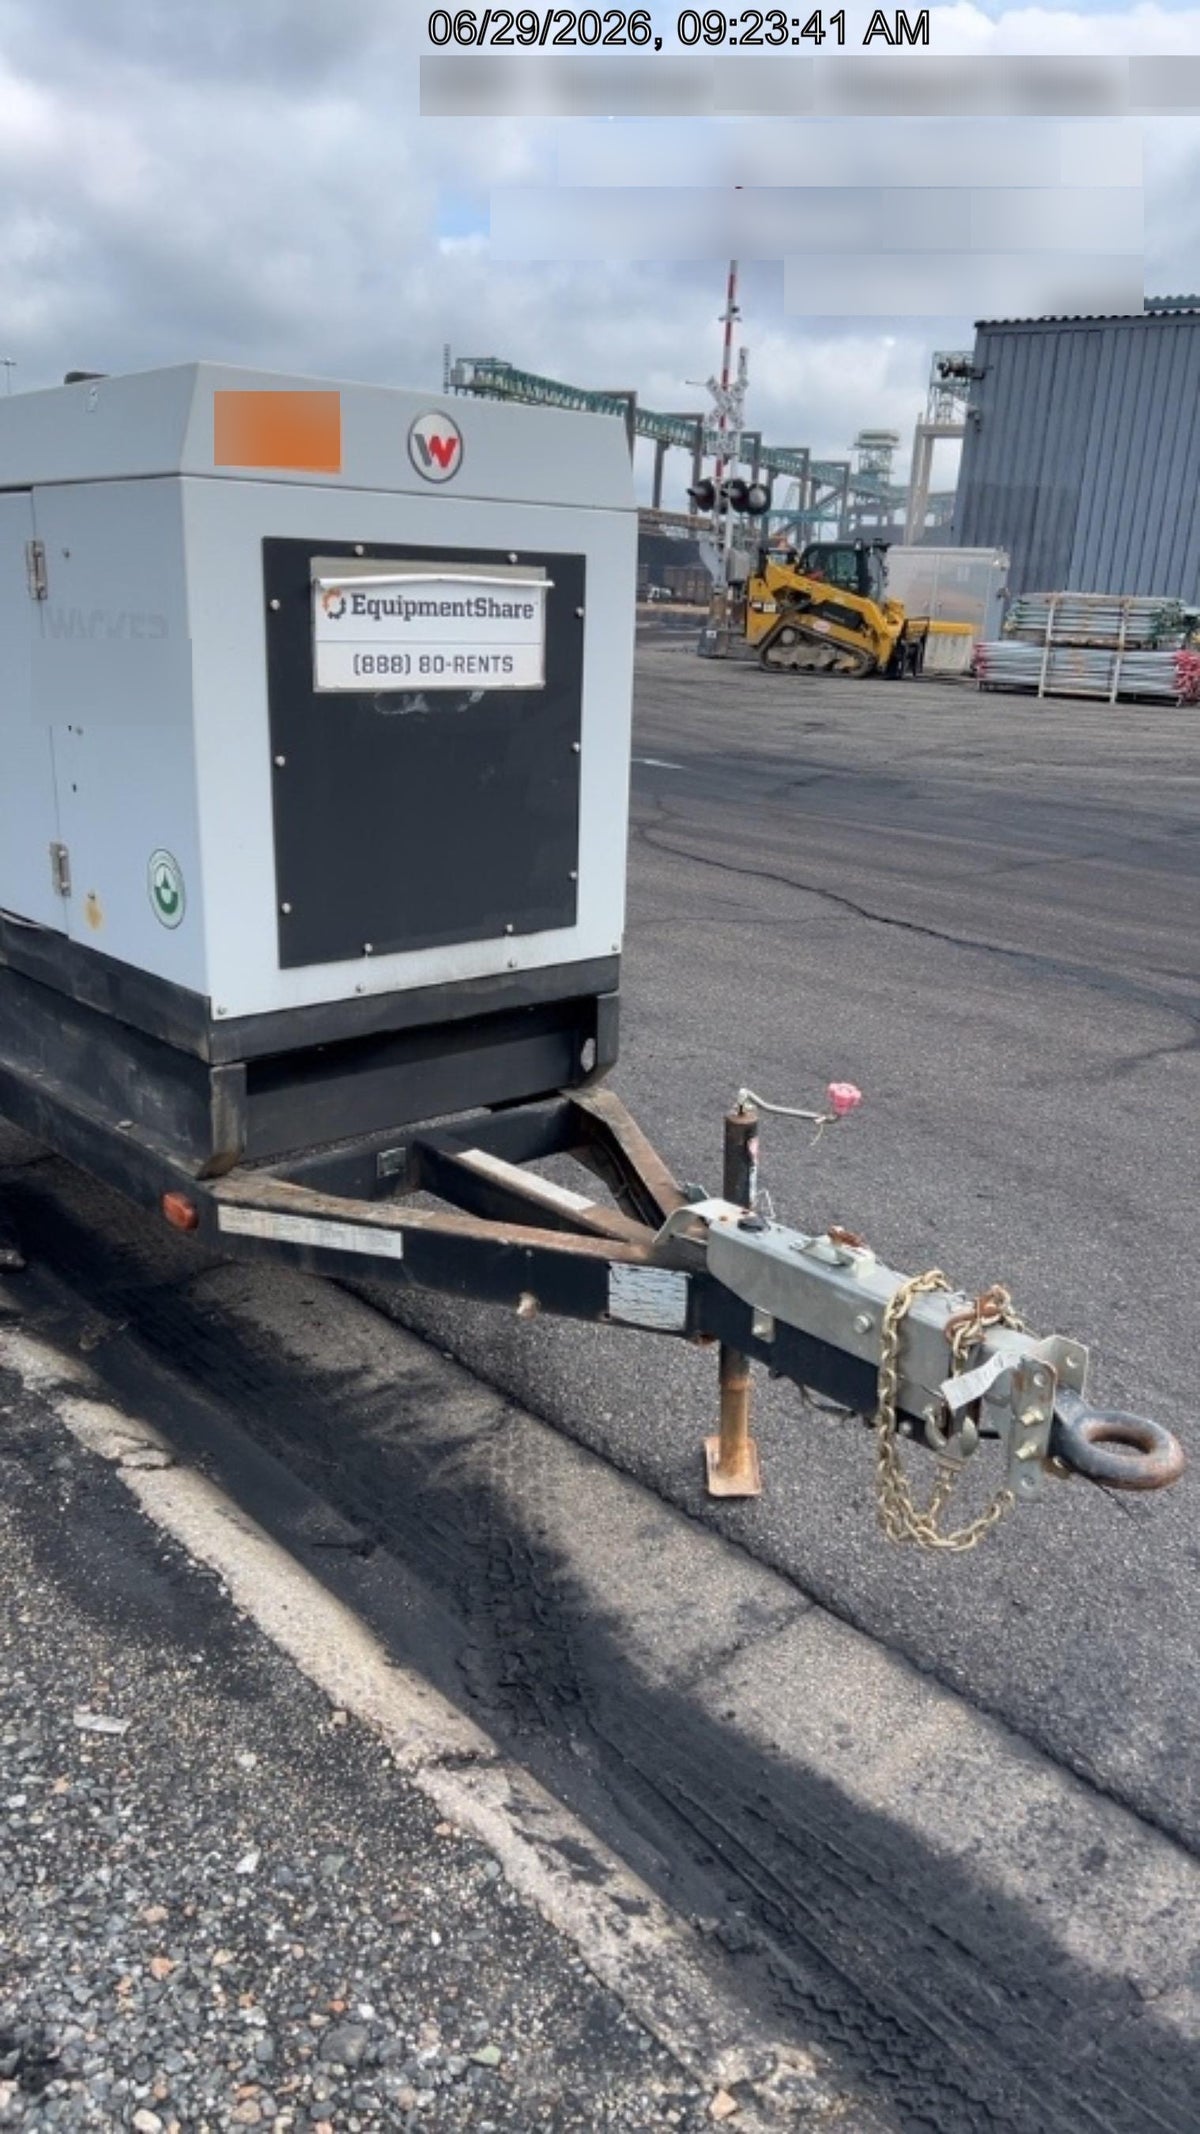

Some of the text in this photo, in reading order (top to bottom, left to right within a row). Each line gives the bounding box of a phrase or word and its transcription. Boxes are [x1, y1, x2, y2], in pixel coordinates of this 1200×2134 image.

[350, 592, 535, 622] EquipmentShare
[353, 654, 514, 675] (888) 80-RENTS
